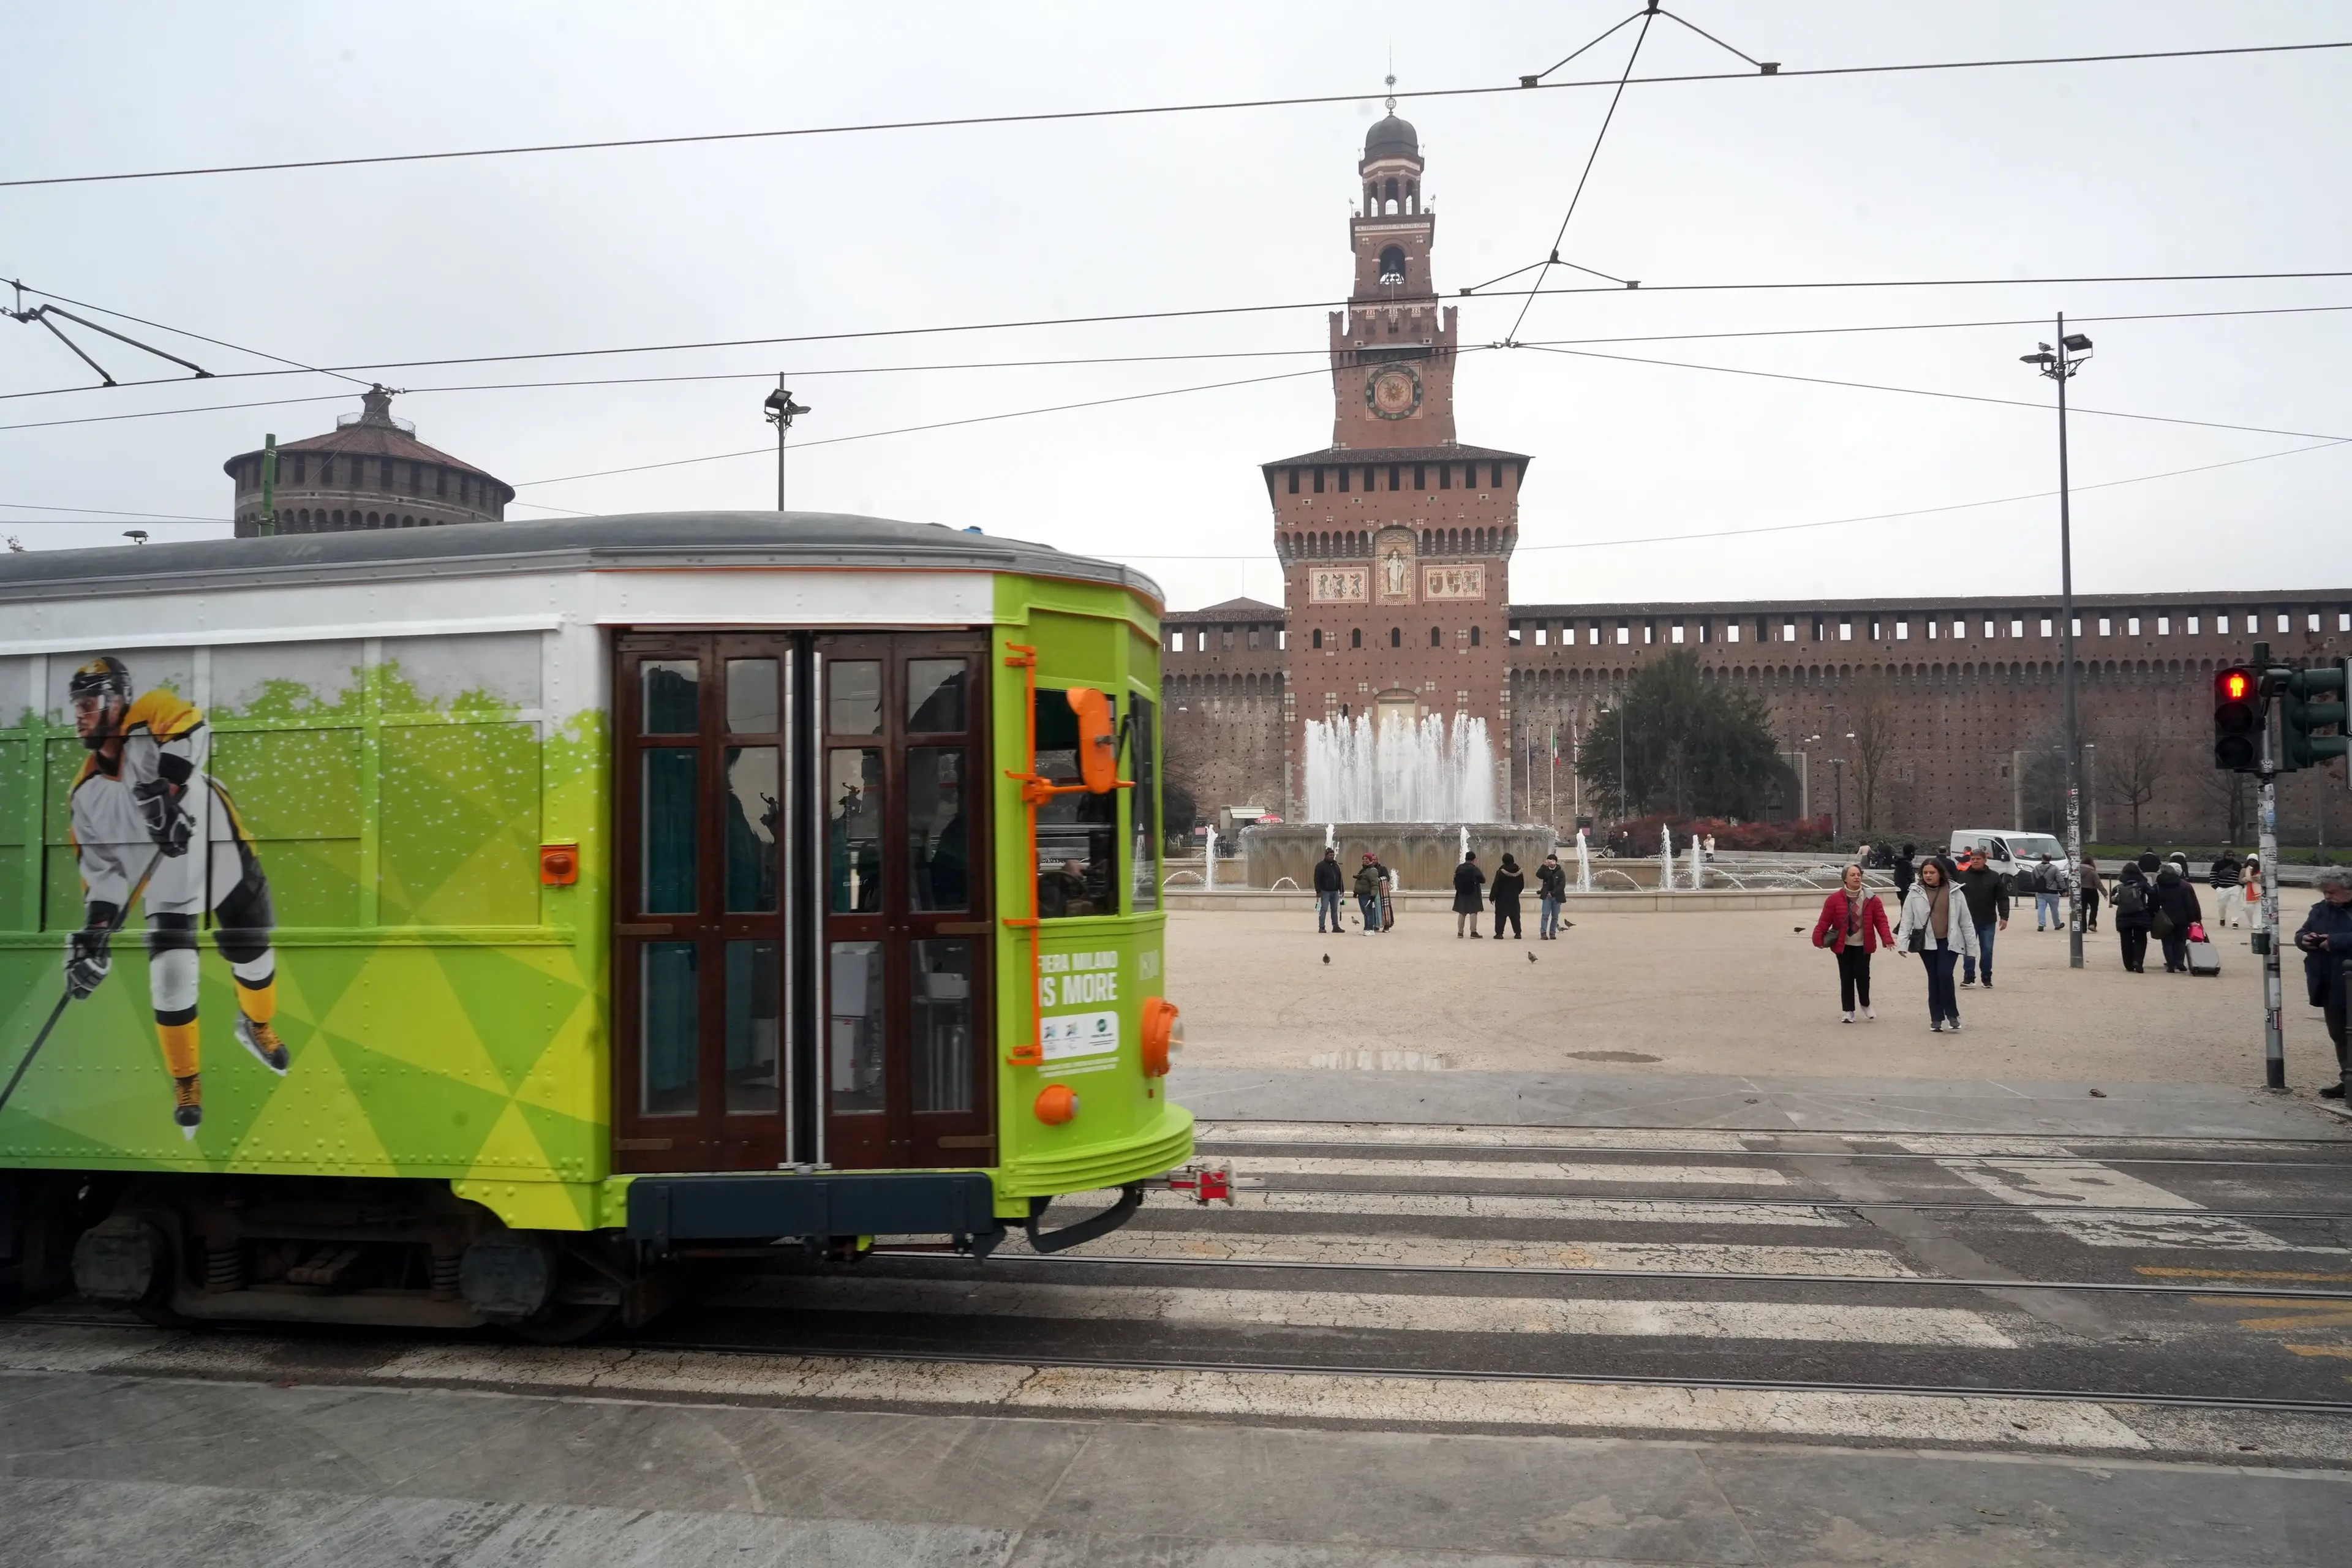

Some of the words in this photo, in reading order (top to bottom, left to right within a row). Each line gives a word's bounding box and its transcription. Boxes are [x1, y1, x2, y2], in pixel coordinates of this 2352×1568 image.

[1072, 951, 1118, 971] MILANO
[1038, 976, 1056, 1007] IS
[1063, 972, 1118, 1005] MORE
